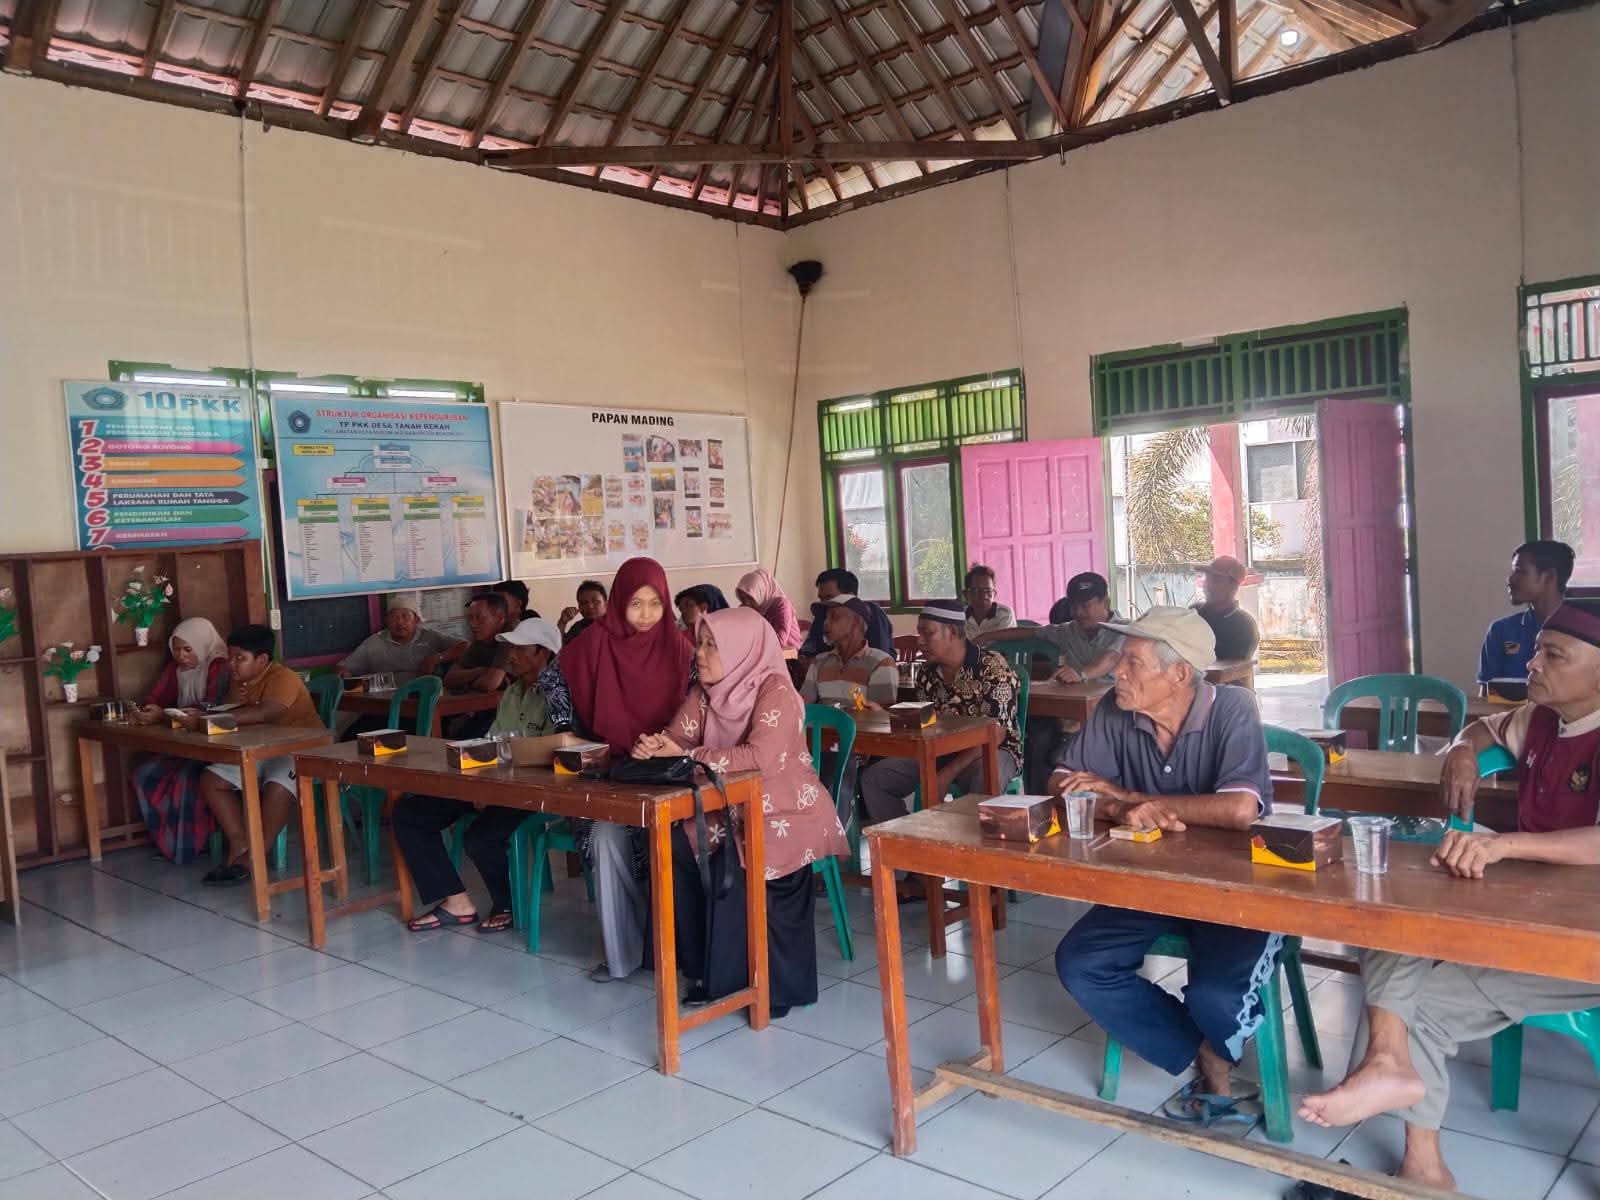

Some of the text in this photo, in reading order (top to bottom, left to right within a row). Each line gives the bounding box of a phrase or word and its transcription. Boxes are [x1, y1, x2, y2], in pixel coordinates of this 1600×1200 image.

[138, 391, 177, 411] 10
[180, 399, 242, 413] PKK
[315, 409, 359, 418] STRUKTUR
[361, 410, 408, 420] ORGANISASI
[592, 412, 674, 427] PAPAN MADING
[79, 420, 99, 437] 1
[352, 421, 369, 429] PKK
[80, 437, 103, 455] 2
[81, 455, 103, 471] 3
[83, 473, 105, 489] 4
[86, 490, 109, 507] 5
[112, 492, 171, 500] PERUMAHAN
[86, 509, 110, 527] 6
[88, 526, 112, 546] 7
